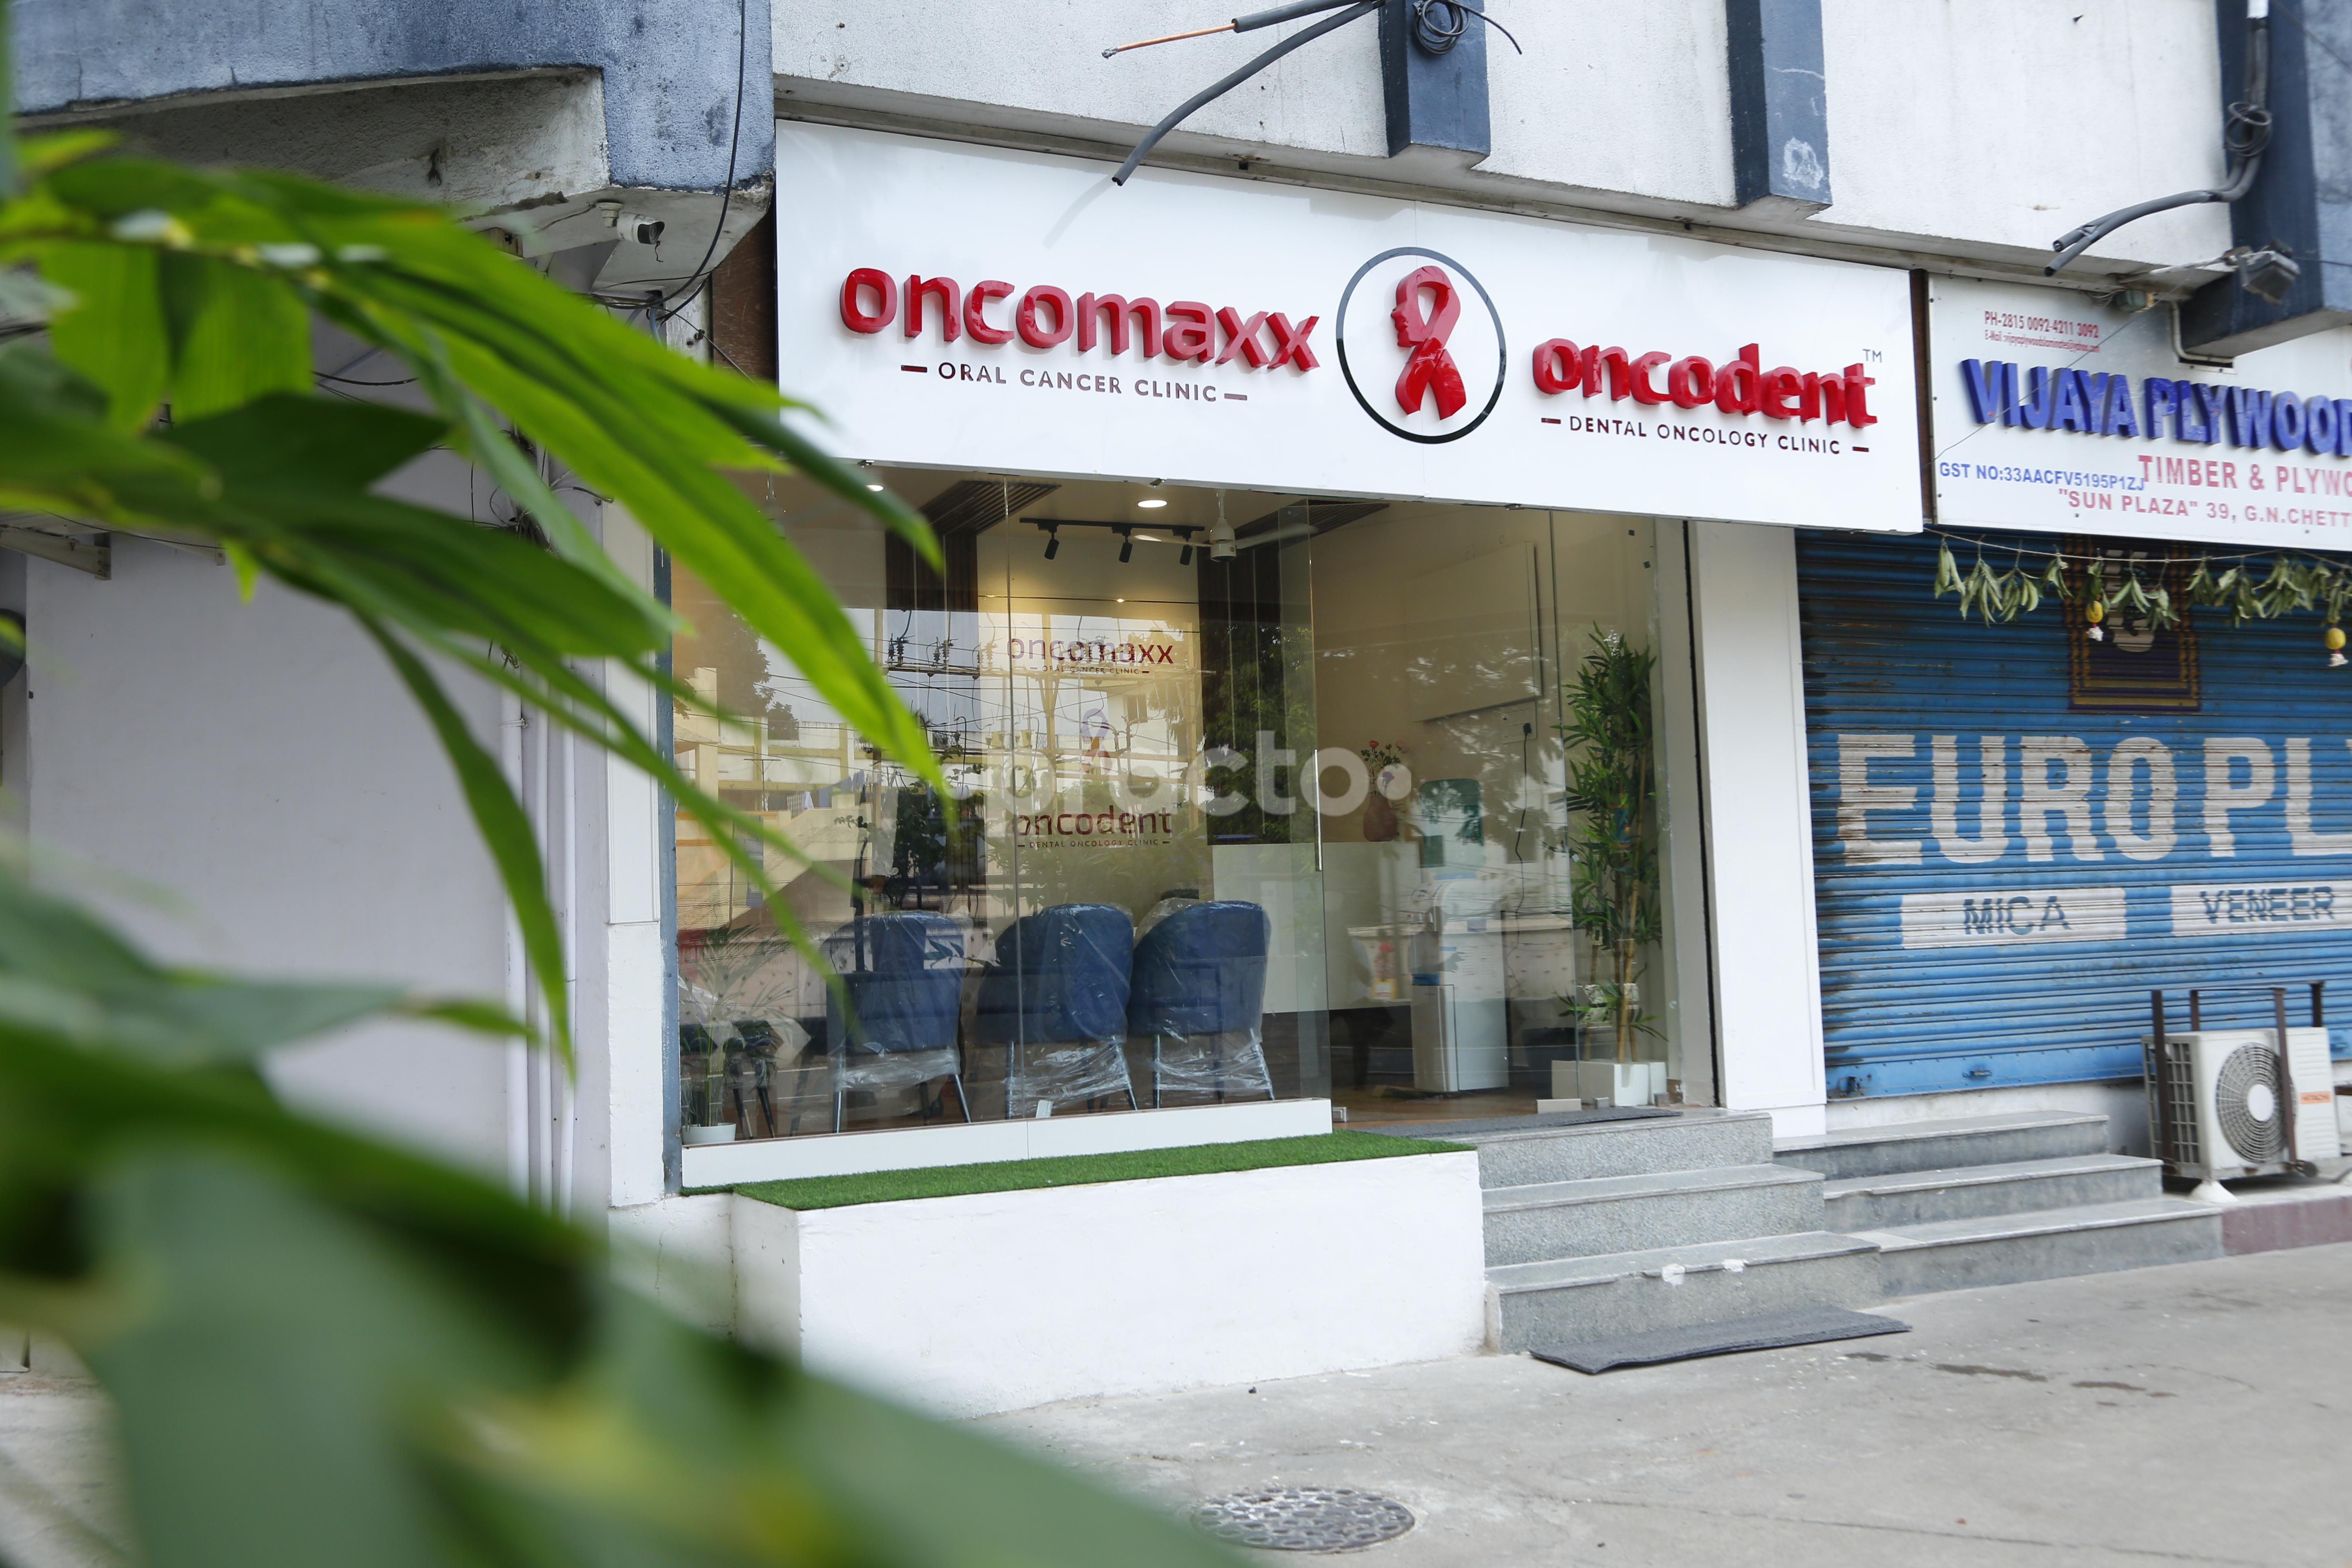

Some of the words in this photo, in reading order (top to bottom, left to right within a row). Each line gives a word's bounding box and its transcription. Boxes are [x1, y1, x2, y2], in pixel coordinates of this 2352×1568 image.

[840, 267, 1321, 371] oncomaxx
[2077, 322, 2099, 338] 3092
[1863, 348, 1882, 363] TM
[938, 362, 1007, 384] ORAL
[1020, 369, 1122, 394] CANCER
[1134, 379, 1216, 402] CLINIC
[1533, 338, 1878, 428] oncodent
[1962, 359, 2139, 437] VIJAYA
[1569, 416, 1647, 437] DENTAL
[1657, 424, 1768, 448] ONCOLOGY
[1777, 436, 1841, 454] CLINIC
[1940, 462, 1971, 478] GST
[2138, 454, 2238, 489] TIMBER
[2249, 463, 2265, 490] &
[2207, 502, 2236, 524] 39,
[1006, 637, 1174, 664] oncomaxx
[1012, 805, 1173, 836] oncodent
[1029, 840, 1065, 849] DENTAL
[1962, 895, 2073, 935] MICA
[2199, 886, 2337, 924] VENEER
